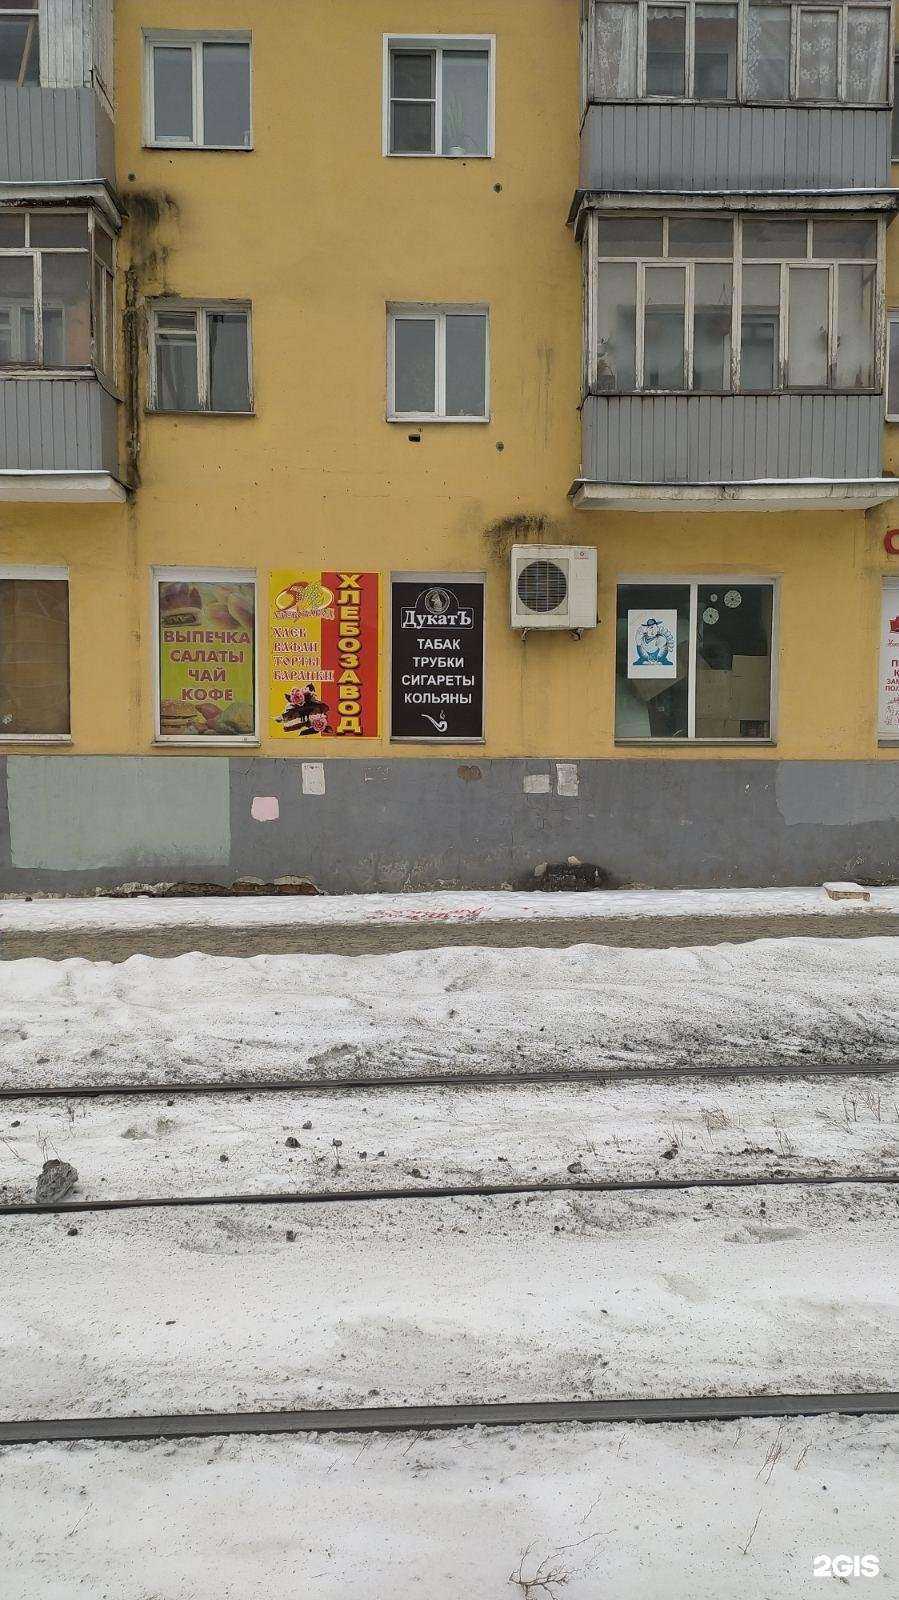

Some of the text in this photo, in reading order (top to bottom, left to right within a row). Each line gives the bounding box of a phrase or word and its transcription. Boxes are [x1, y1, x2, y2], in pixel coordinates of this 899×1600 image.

[402, 610, 472, 629] ДукатЪ
[163, 630, 251, 644] ВЫПЕЧКА
[417, 638, 461, 650] ТАБАК
[169, 650, 244, 663] САЛАТЫ
[273, 656, 319, 666] ТОРТЫ
[336, 573, 363, 736] ХЛЕБОЗАВОД
[413, 656, 464, 668] ТРУБКИ
[188, 668, 226, 682] ЧАЙ
[273, 670, 333, 681] БАРАНКИ
[401, 674, 475, 687] СИГАРЕТЫ
[181, 688, 233, 701] КОФЕ
[404, 692, 472, 704] КОЛЬЯНЫ
